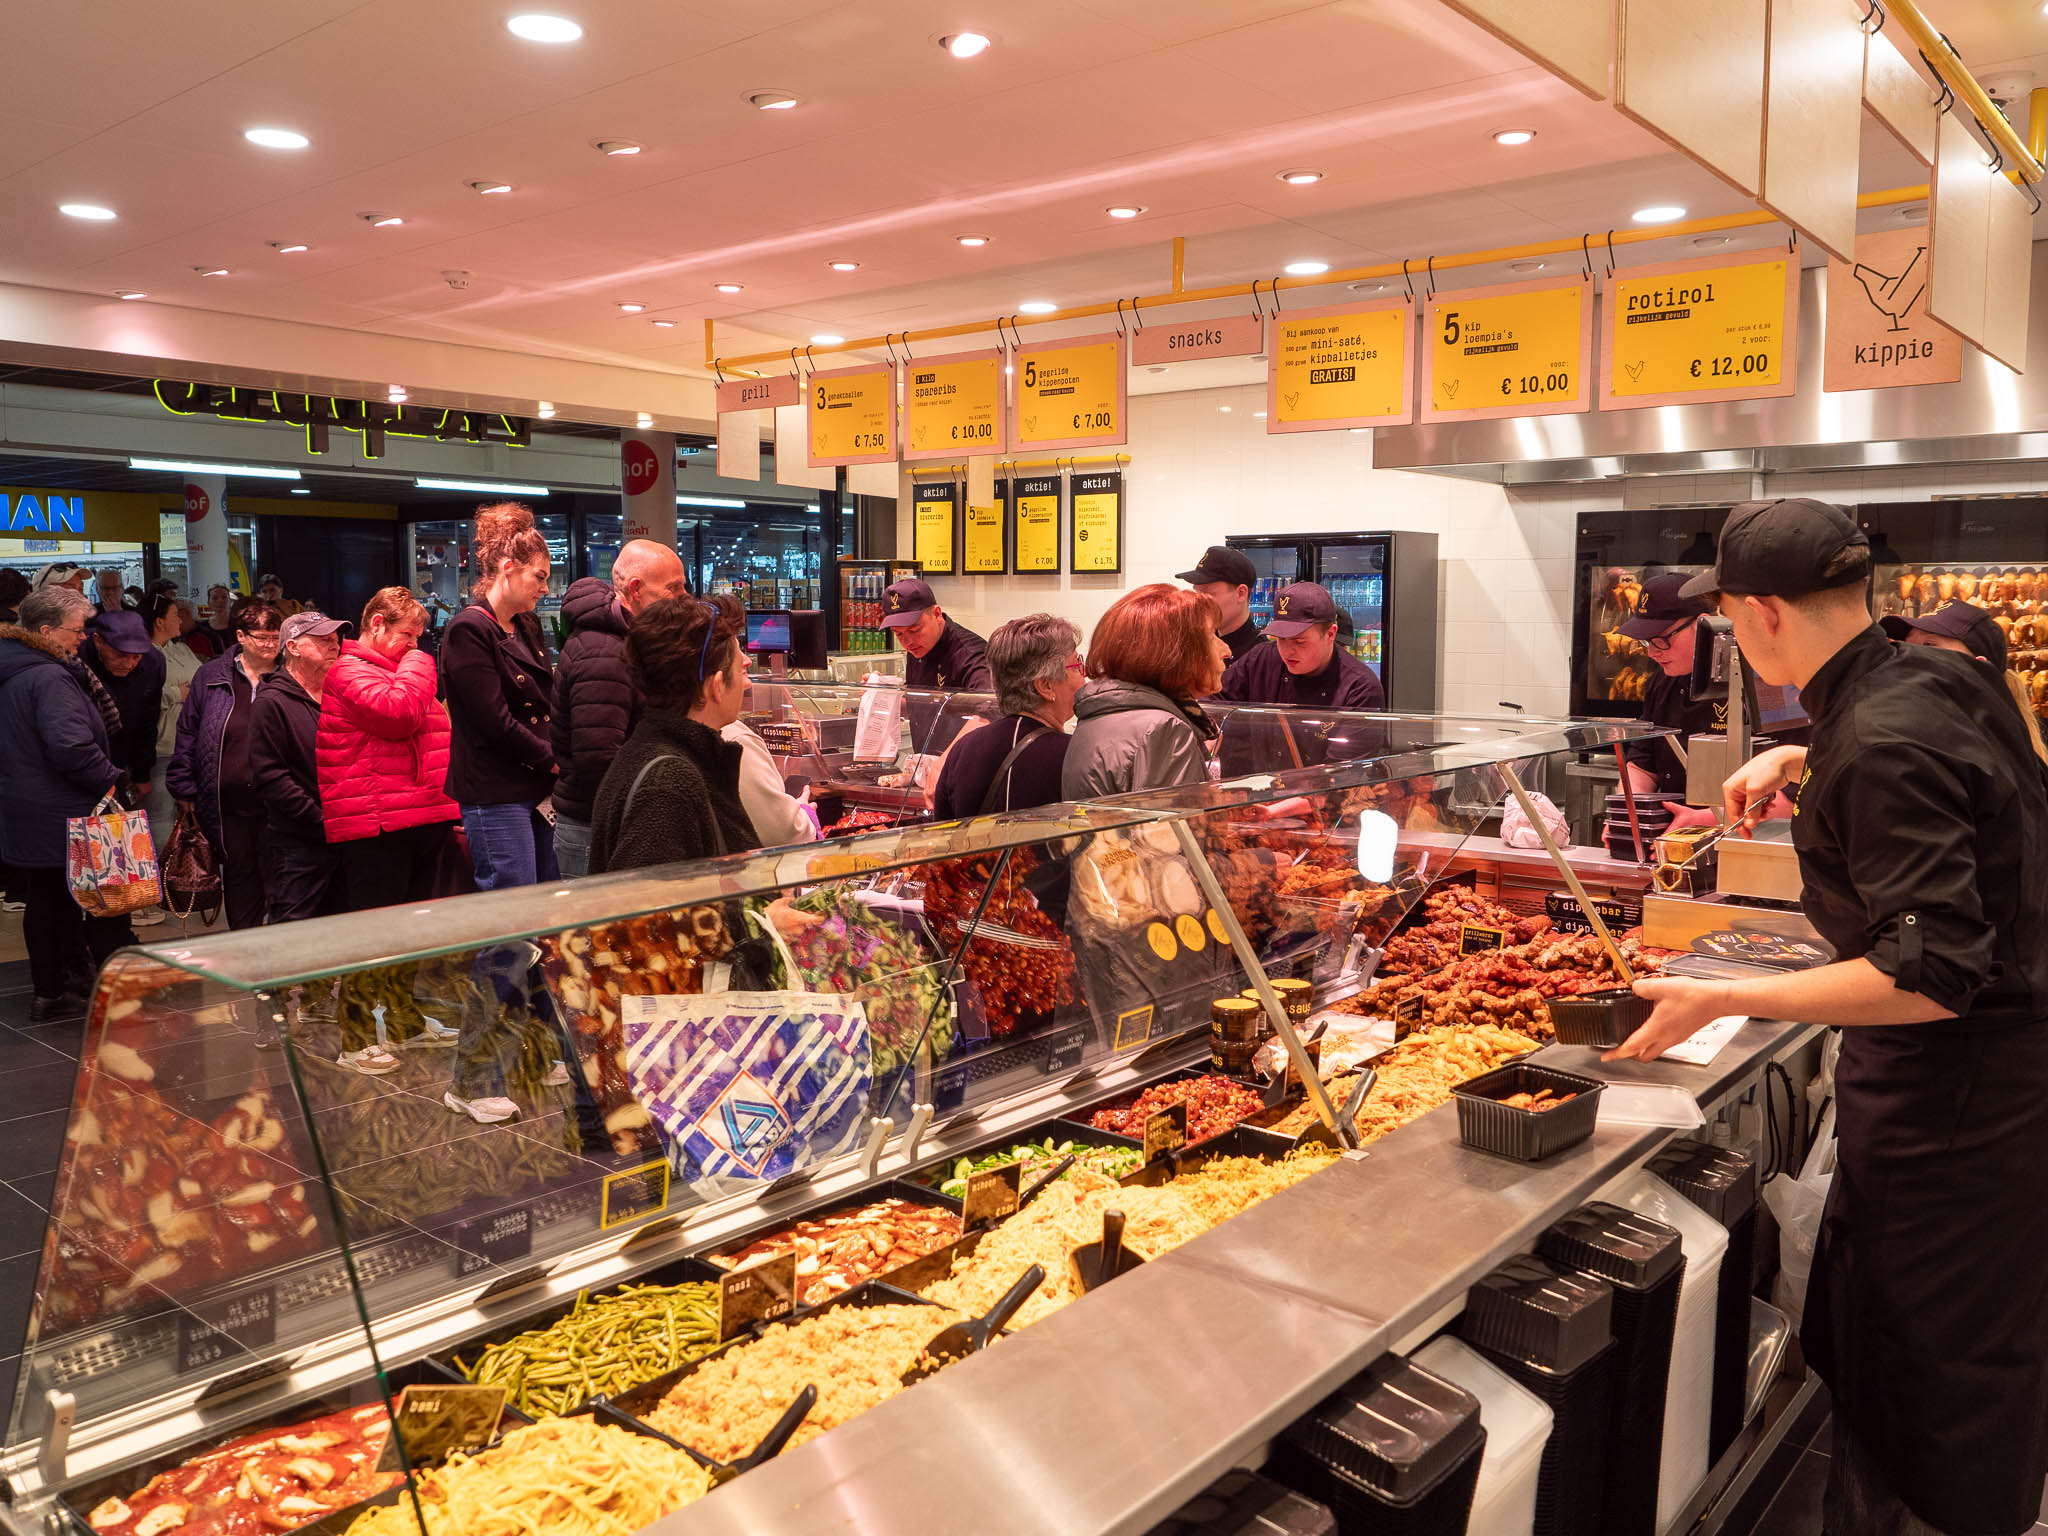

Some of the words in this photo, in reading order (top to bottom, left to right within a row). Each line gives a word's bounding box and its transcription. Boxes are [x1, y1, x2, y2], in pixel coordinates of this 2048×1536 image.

[1627, 284, 1715, 311] rotirol
[1628, 312, 1663, 324] rijkelijk
[1665, 309, 1690, 320] gevuld
[1286, 330, 1297, 338] Bij
[1300, 327, 1326, 338] aankoop
[1443, 312, 1459, 345] 5
[1464, 322, 1481, 331] kip
[1169, 329, 1222, 349] snacks
[1464, 330, 1513, 344] loempia's
[1742, 336, 1747, 344] 2
[1750, 335, 1772, 344] voor:
[1310, 350, 1378, 364] kipballetjes
[1855, 339, 1933, 367] kippie
[1690, 359, 1702, 377] €
[1711, 353, 1768, 376] 12,00
[1025, 361, 1036, 388] 5
[1039, 376, 1080, 387] kippenpoten
[1311, 368, 1353, 383] GRATIS!
[915, 384, 957, 398] spareribs
[1501, 378, 1511, 395] €
[1519, 373, 1568, 395] 10,00
[742, 384, 770, 402] grill
[817, 387, 826, 410] 3
[1073, 415, 1080, 429] €
[1085, 412, 1110, 429] 7,00
[952, 426, 958, 439] €
[963, 423, 992, 439] 10,00
[855, 435, 860, 447] €
[864, 433, 884, 448] 7,50
[1025, 481, 1052, 492] aktie!
[1082, 478, 1111, 489] aktie!
[923, 488, 947, 497] aktie!
[0, 494, 85, 533] AN
[969, 506, 975, 520] 5
[1021, 502, 1028, 518] 5
[1041, 557, 1053, 565] 7,00
[1563, 902, 1621, 917] dipebar
[728, 1277, 751, 1294] nasi
